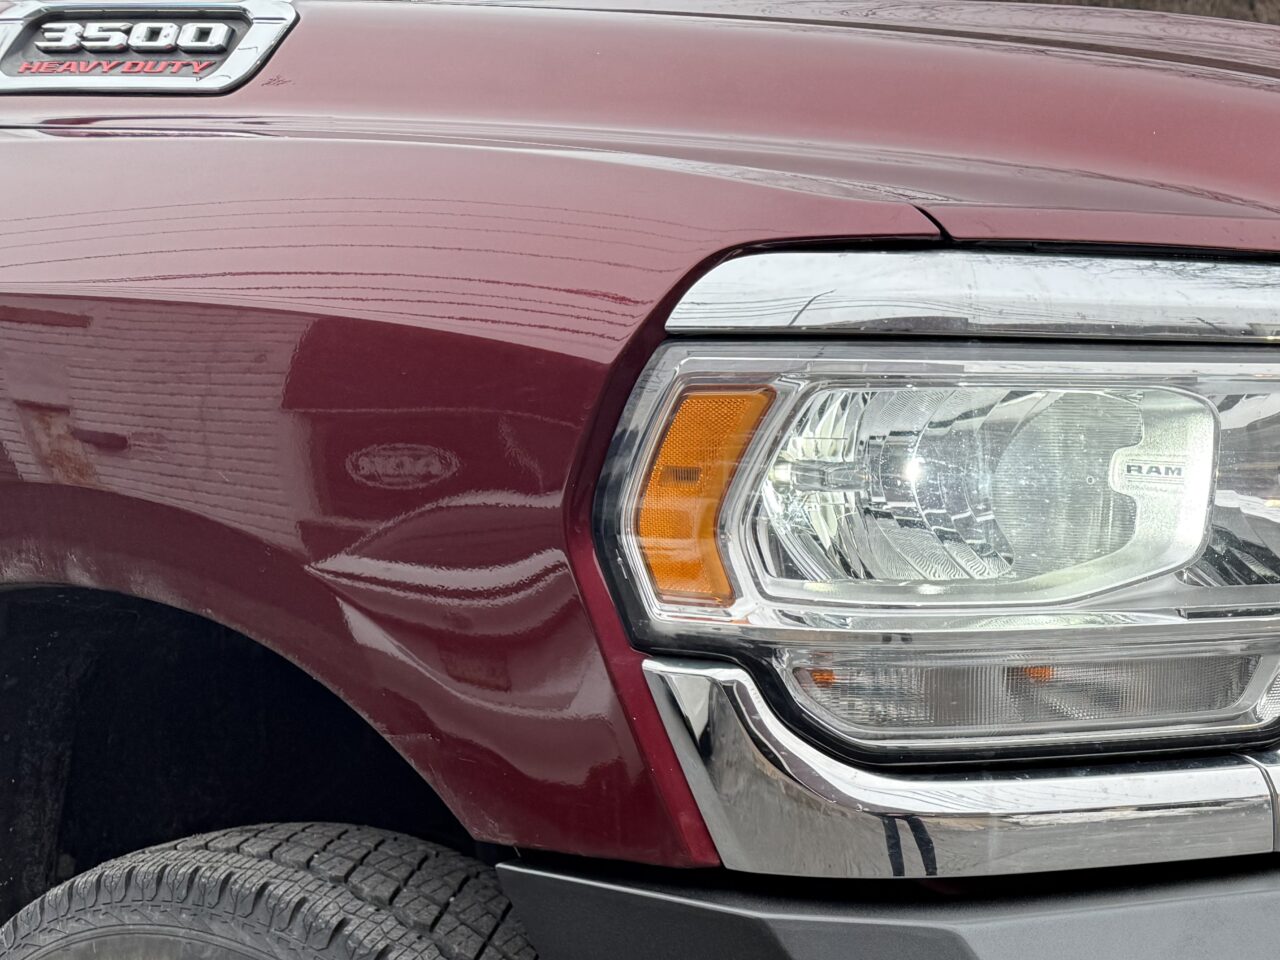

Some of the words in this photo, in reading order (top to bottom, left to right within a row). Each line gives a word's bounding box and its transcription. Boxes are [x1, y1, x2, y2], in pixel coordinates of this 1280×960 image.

[33, 22, 236, 52] 3500
[18, 60, 121, 74] HEAVY
[118, 60, 217, 75] DUTY
[1126, 464, 1183, 476] RAM
